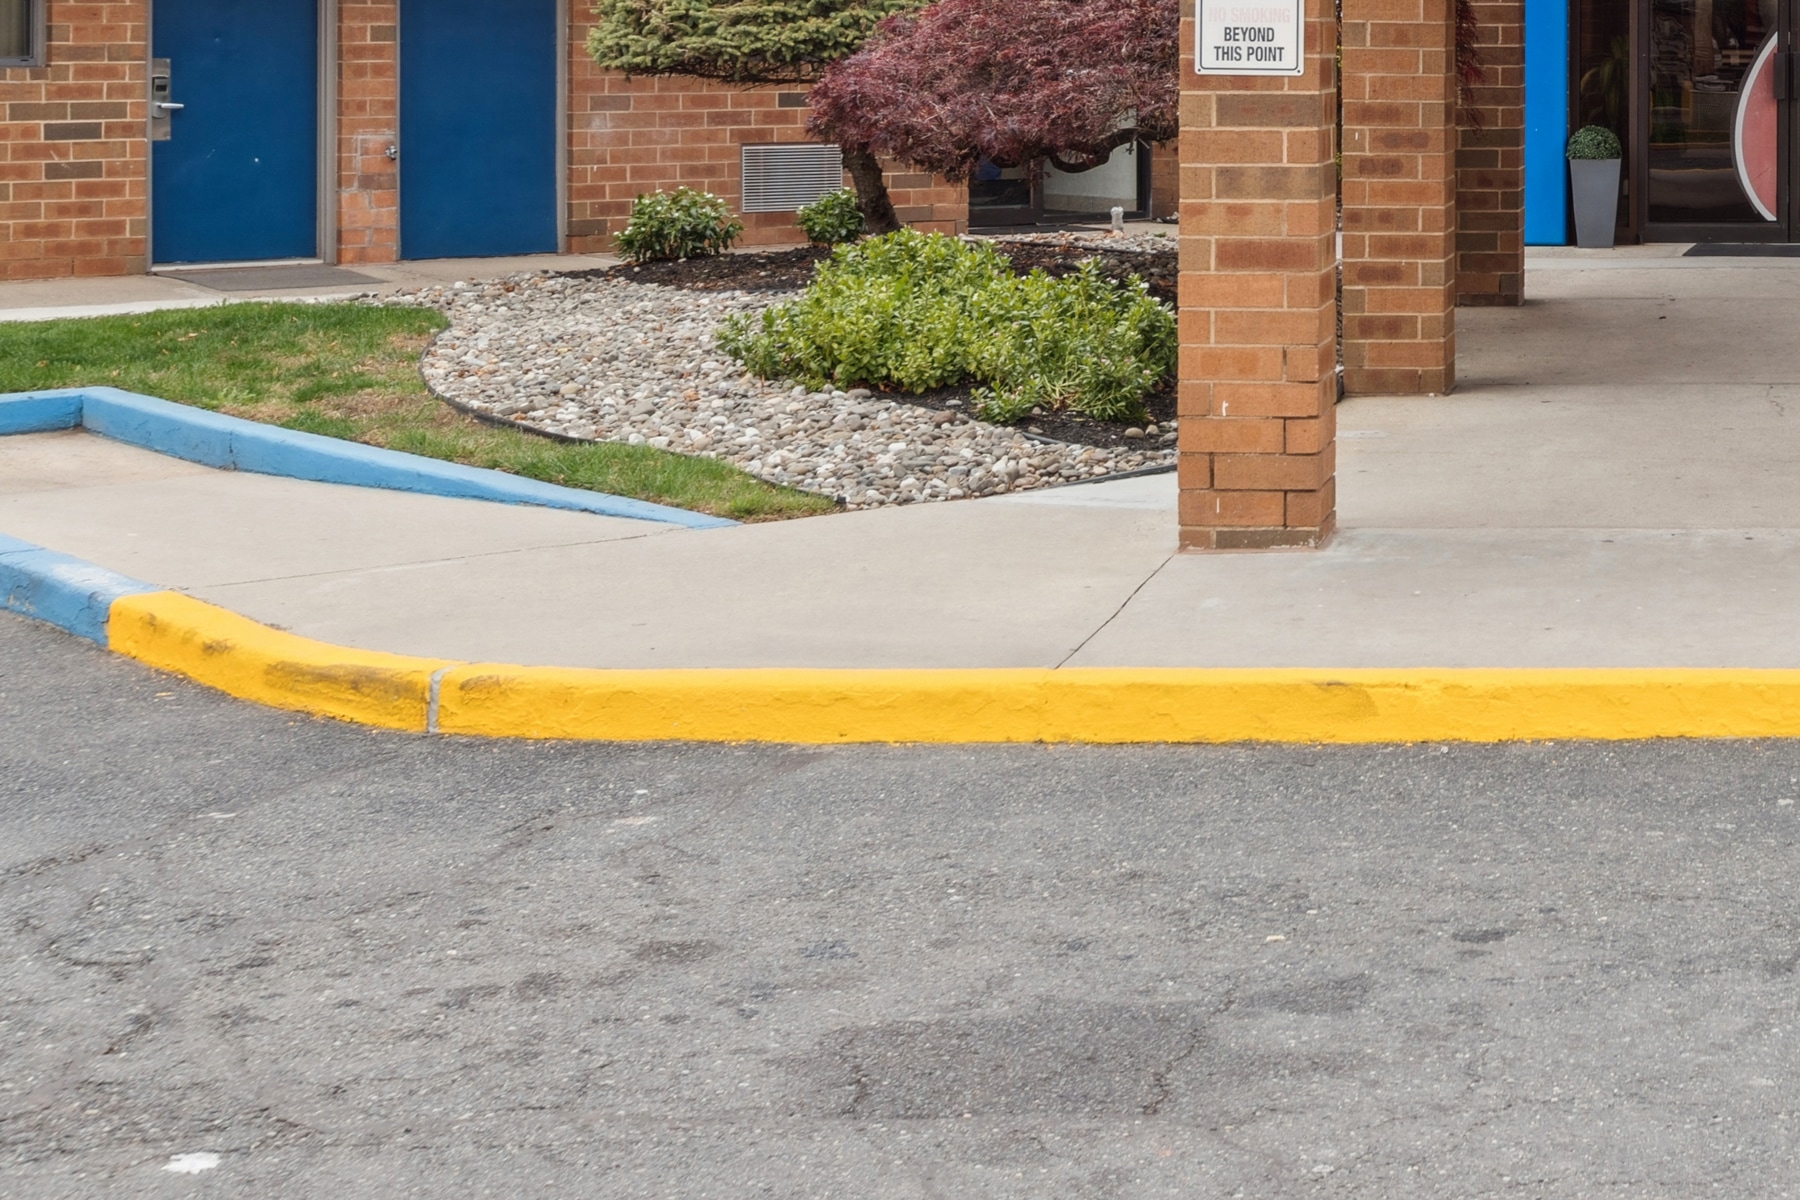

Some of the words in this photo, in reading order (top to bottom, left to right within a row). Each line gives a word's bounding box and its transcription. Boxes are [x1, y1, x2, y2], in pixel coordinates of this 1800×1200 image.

[1209, 7, 1226, 23] NO
[1231, 7, 1291, 24] SMOKING
[1224, 27, 1275, 42] BEYOND
[1213, 46, 1242, 62] THIS
[1246, 46, 1285, 62] POINT
